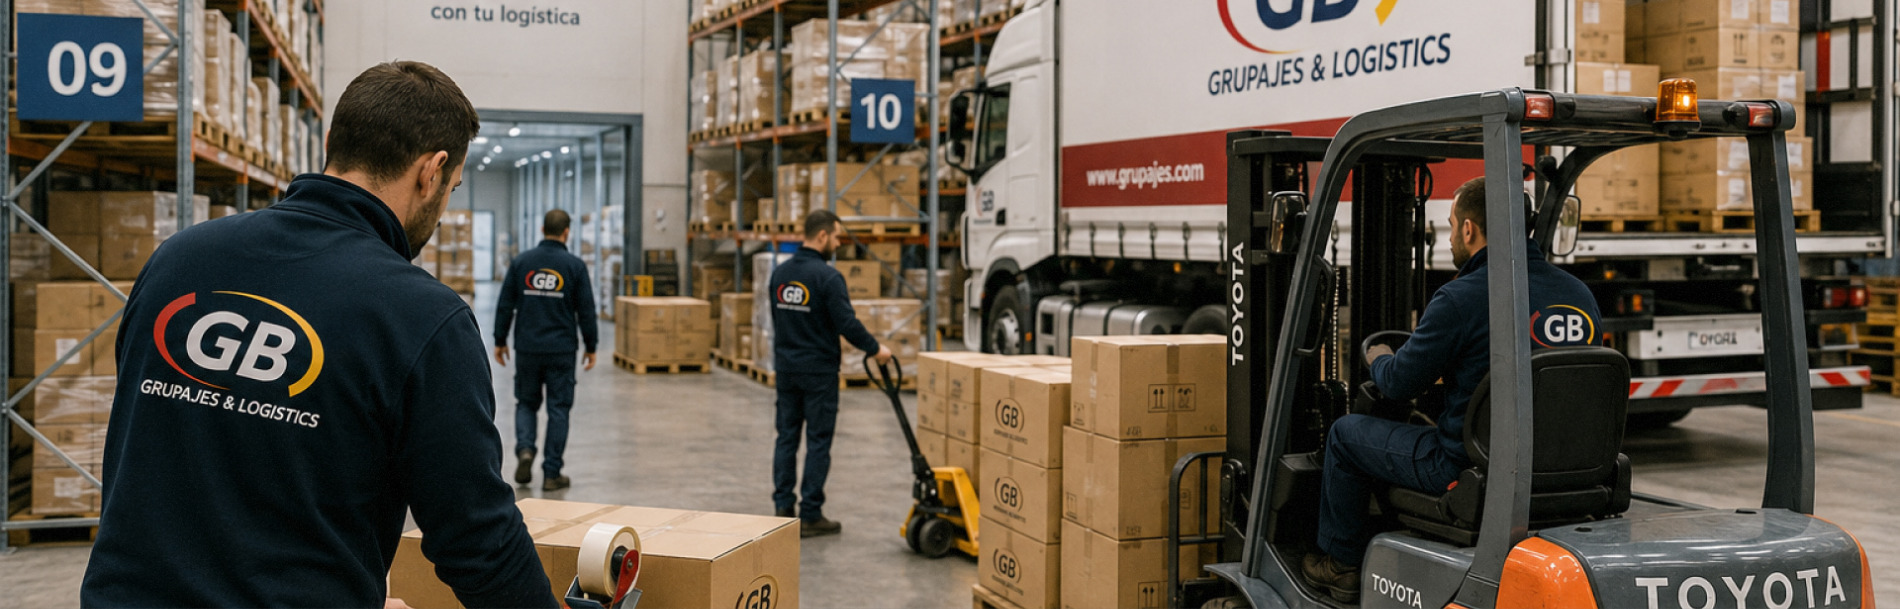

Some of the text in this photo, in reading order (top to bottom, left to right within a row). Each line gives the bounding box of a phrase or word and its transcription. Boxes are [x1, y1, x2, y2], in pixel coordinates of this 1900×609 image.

[430, 5, 580, 27] con tu logística
[48, 40, 127, 97] 09
[1208, 33, 1451, 96] GRUPAJES & LOGISTICS
[861, 93, 902, 131] 10
[1086, 160, 1204, 190] www.grupajes.com
[533, 272, 557, 290] GB
[782, 286, 803, 304] GB
[1231, 242, 1244, 366] TOYOTA
[1544, 314, 1584, 342] GB
[186, 310, 296, 382] GB
[140, 379, 320, 428] GRUPAJES & LOGISTICS
[1001, 404, 1019, 428] GB
[1000, 483, 1018, 507] GB
[998, 554, 1016, 578] GB
[745, 583, 771, 609] GB
[1371, 573, 1422, 609] TOYOTA
[1635, 566, 1846, 609] TOYOTA
